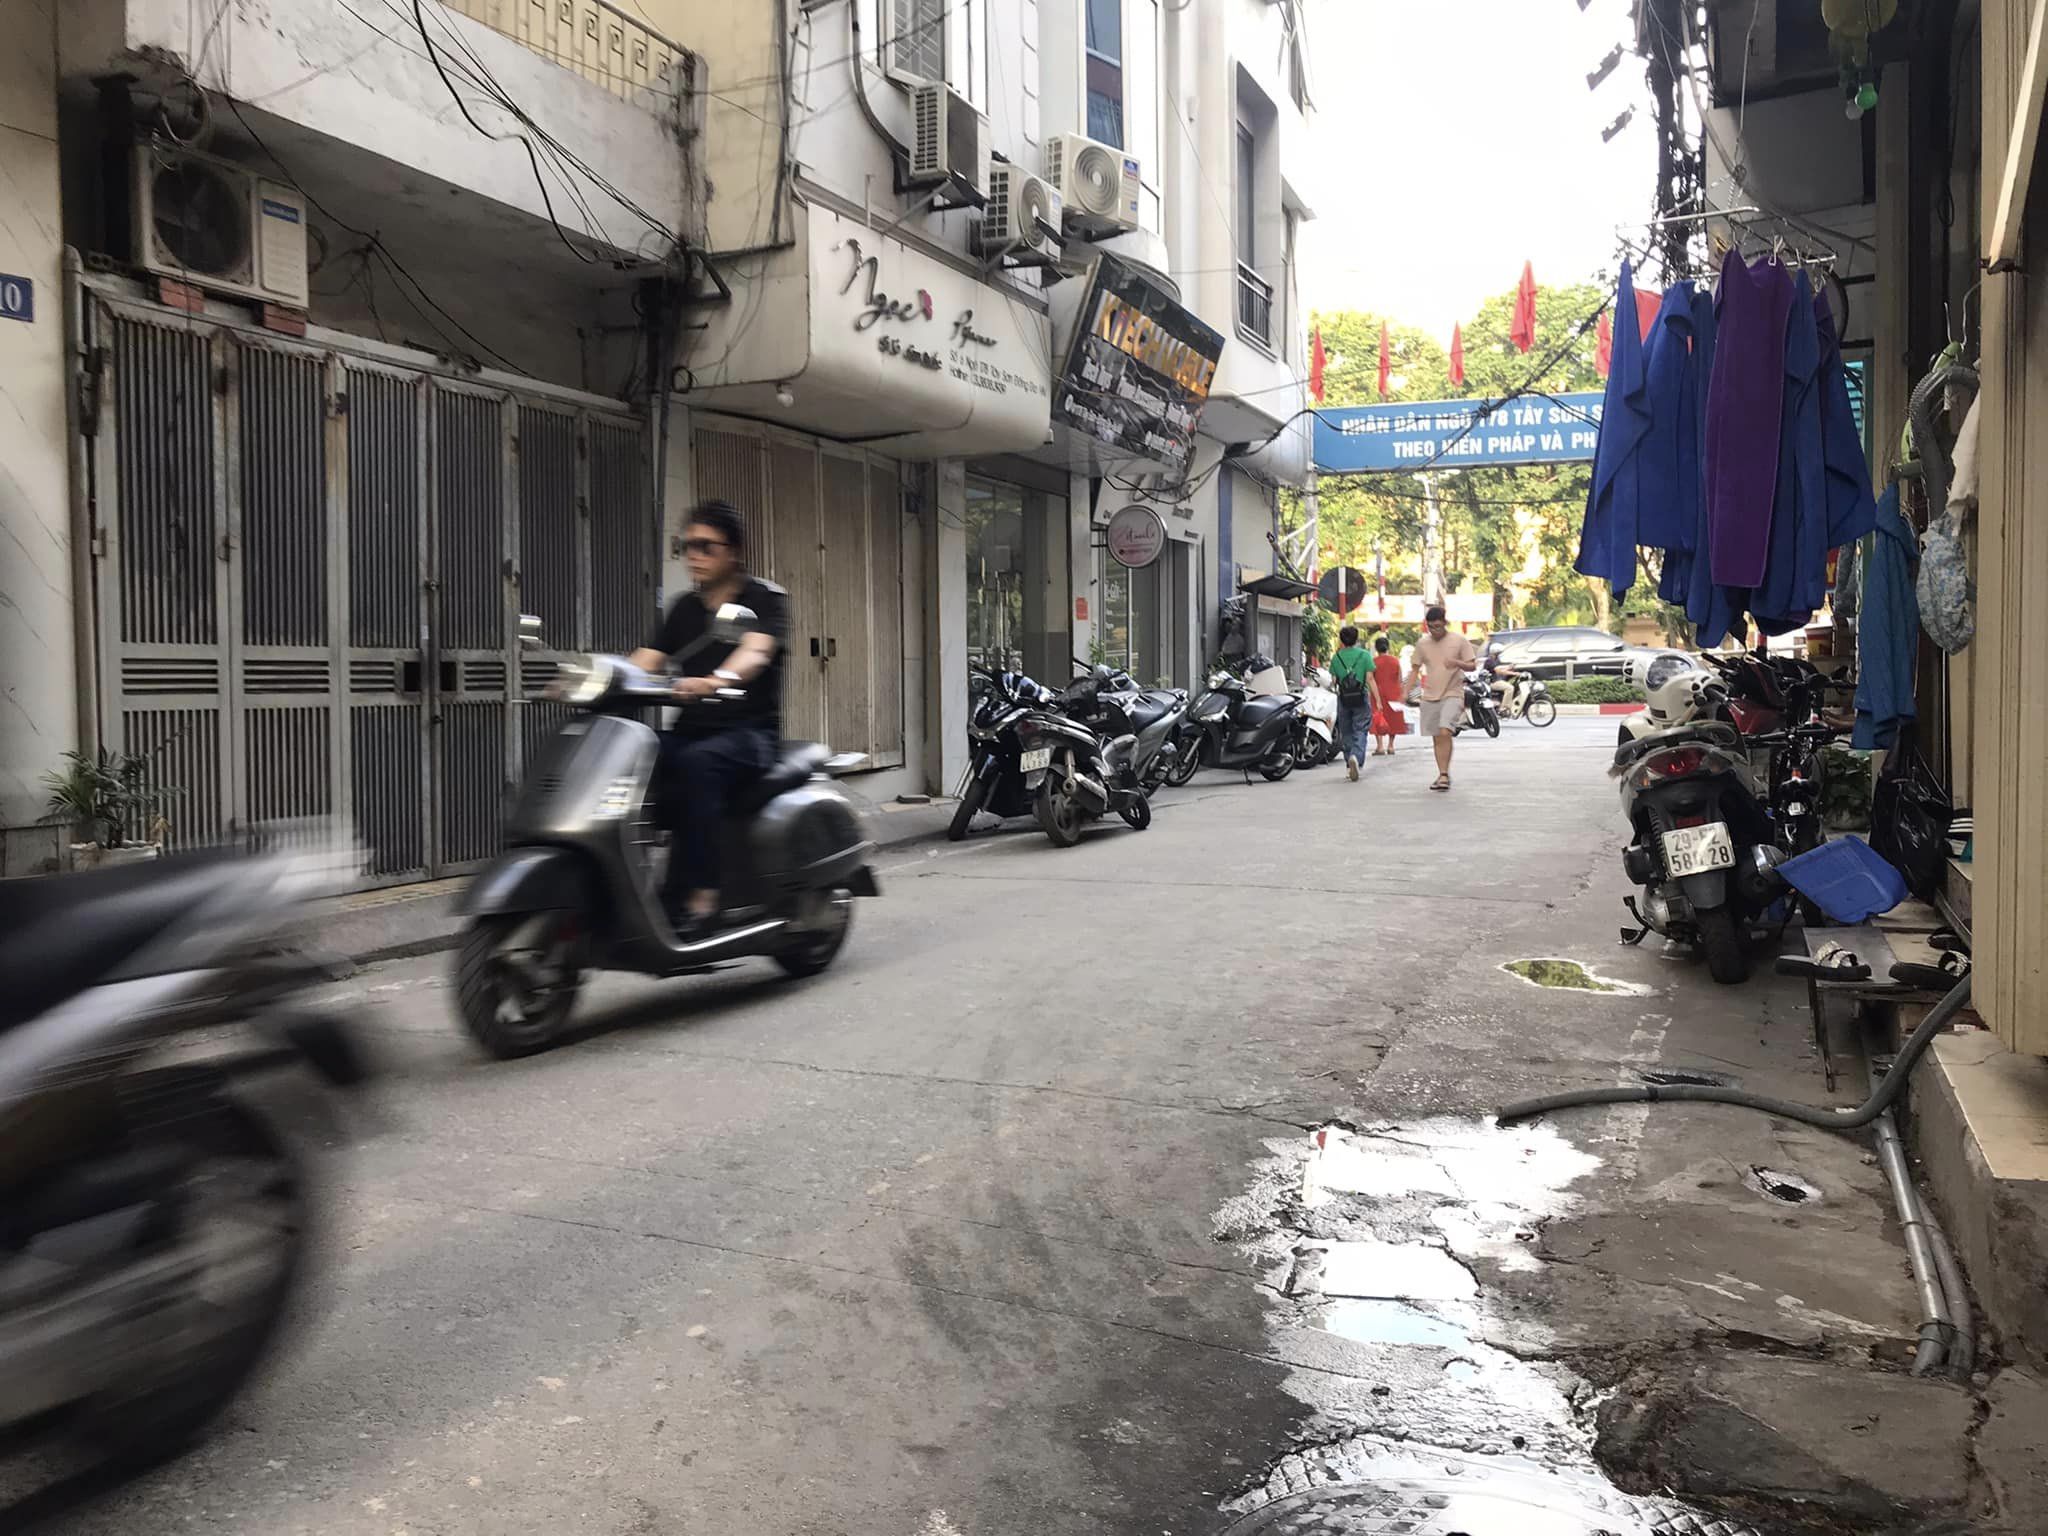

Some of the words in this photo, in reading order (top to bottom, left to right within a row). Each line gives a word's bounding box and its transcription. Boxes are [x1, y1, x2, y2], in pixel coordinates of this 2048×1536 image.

[0, 281, 21, 313] 0
[1342, 414, 1390, 436] NHÂN
[1394, 411, 1432, 433] DÂN
[1513, 404, 1544, 426] TÂY
[1392, 440, 1435, 458] THEO
[1487, 431, 1536, 454] PHÁP
[1540, 429, 1564, 450] VÀ
